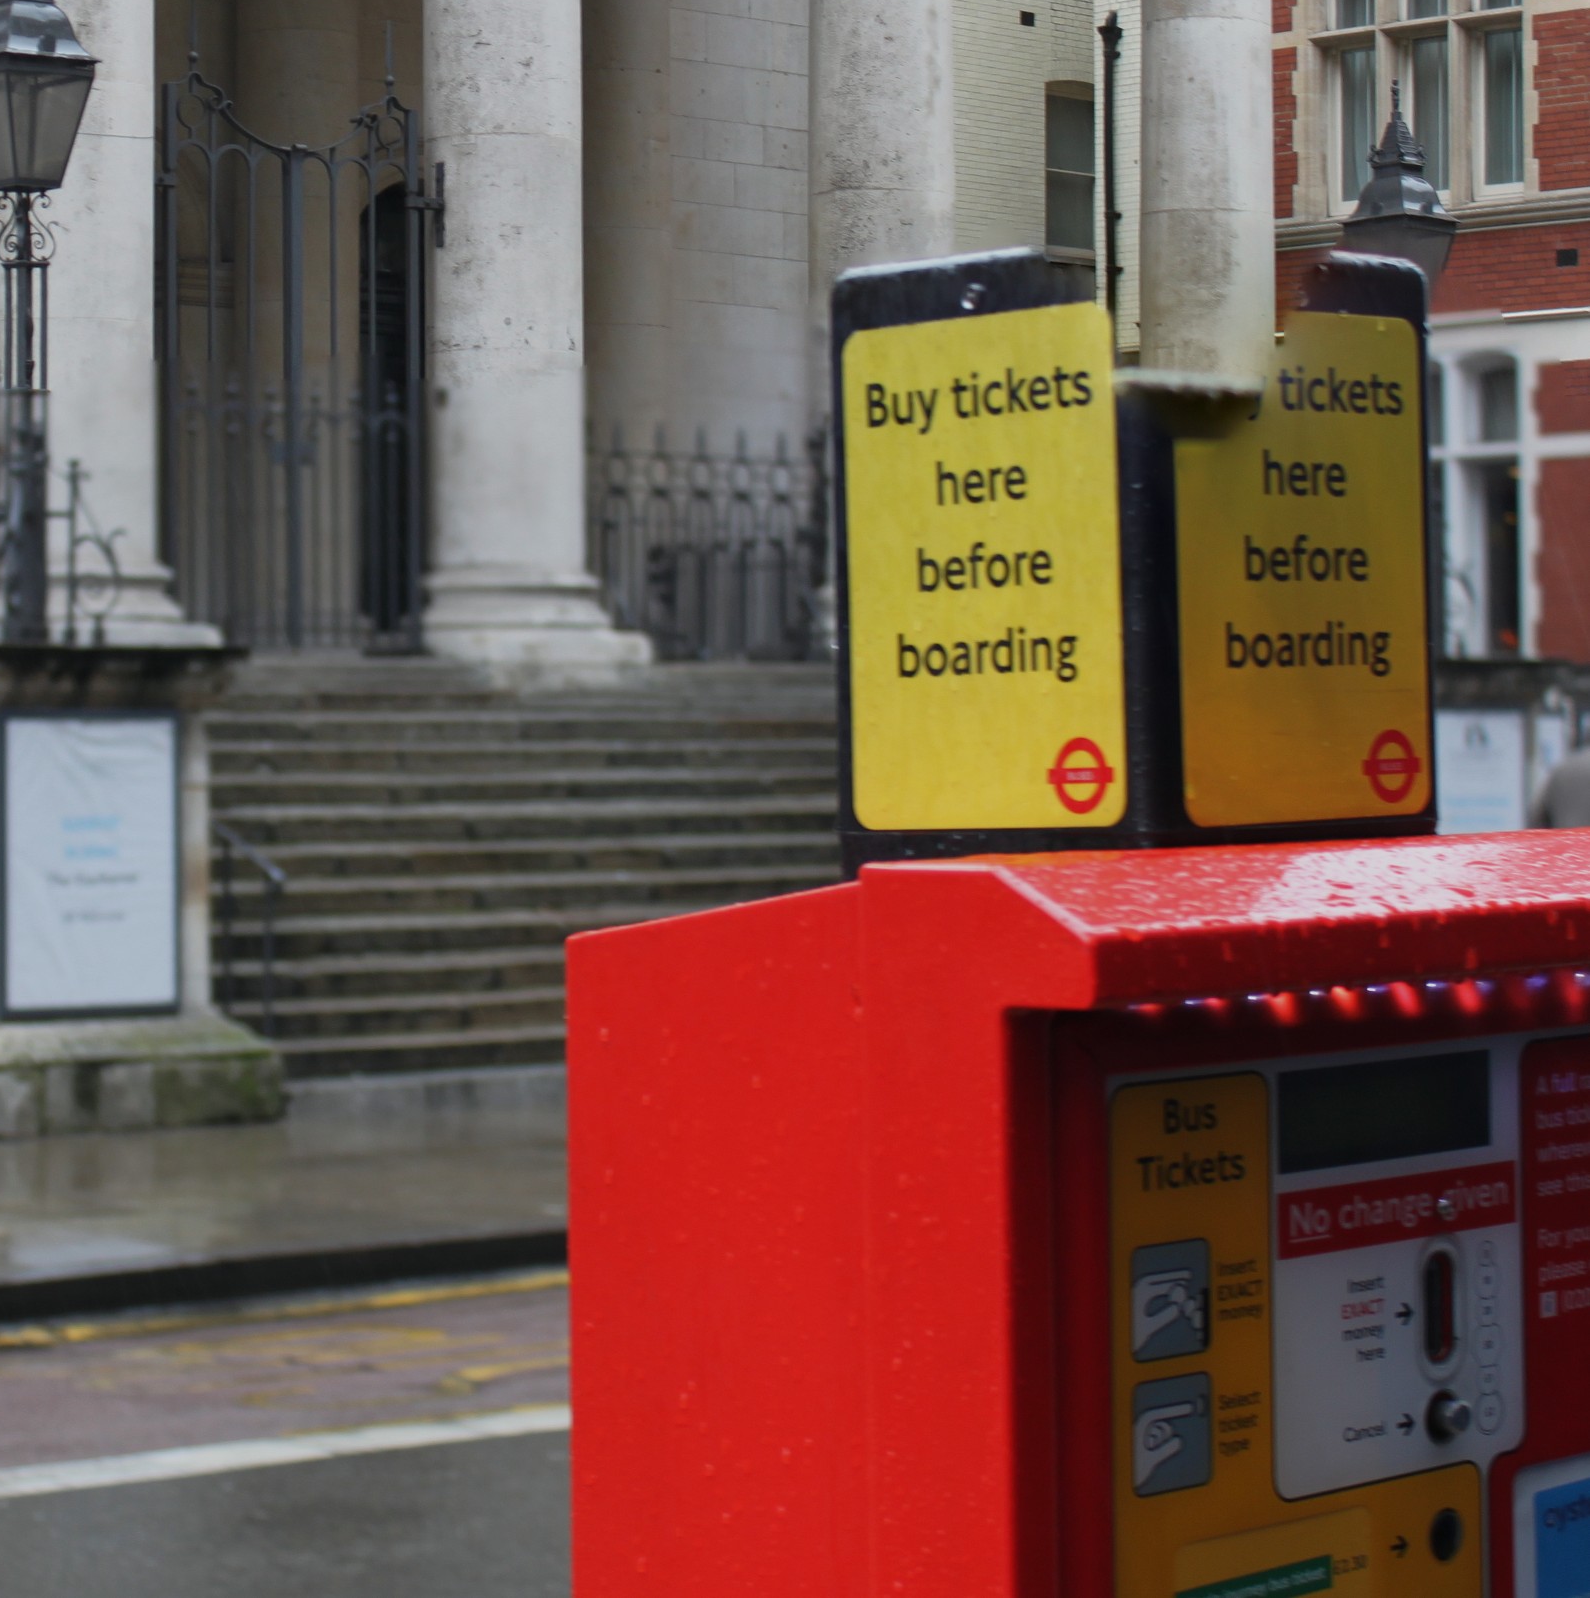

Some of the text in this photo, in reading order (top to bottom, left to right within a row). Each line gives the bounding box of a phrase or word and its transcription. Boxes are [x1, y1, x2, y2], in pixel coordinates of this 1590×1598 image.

[865, 366, 1092, 435] Buy tickets
[1278, 367, 1403, 416] tickets
[935, 460, 1027, 506] here
[1263, 449, 1346, 497] here
[917, 542, 1053, 593] before
[1245, 535, 1369, 582] before
[897, 627, 1078, 682] boarding
[1225, 622, 1391, 677] boarding
[1162, 1098, 1218, 1135] Bus
[1136, 1150, 1247, 1192] Tickets
[1288, 1180, 1509, 1237] No change given
[1217, 1259, 1257, 1276] Insert
[1217, 1280, 1264, 1301] EXACT
[1348, 1276, 1385, 1293] Insert
[1218, 1305, 1263, 1322] money
[1341, 1299, 1384, 1320] EXACT
[1341, 1324, 1384, 1342] money
[1356, 1346, 1386, 1362] here
[1218, 1390, 1263, 1412] Select
[1219, 1413, 1259, 1434] ticket
[1343, 1424, 1388, 1443] Cancel
[1219, 1435, 1251, 1457] type
